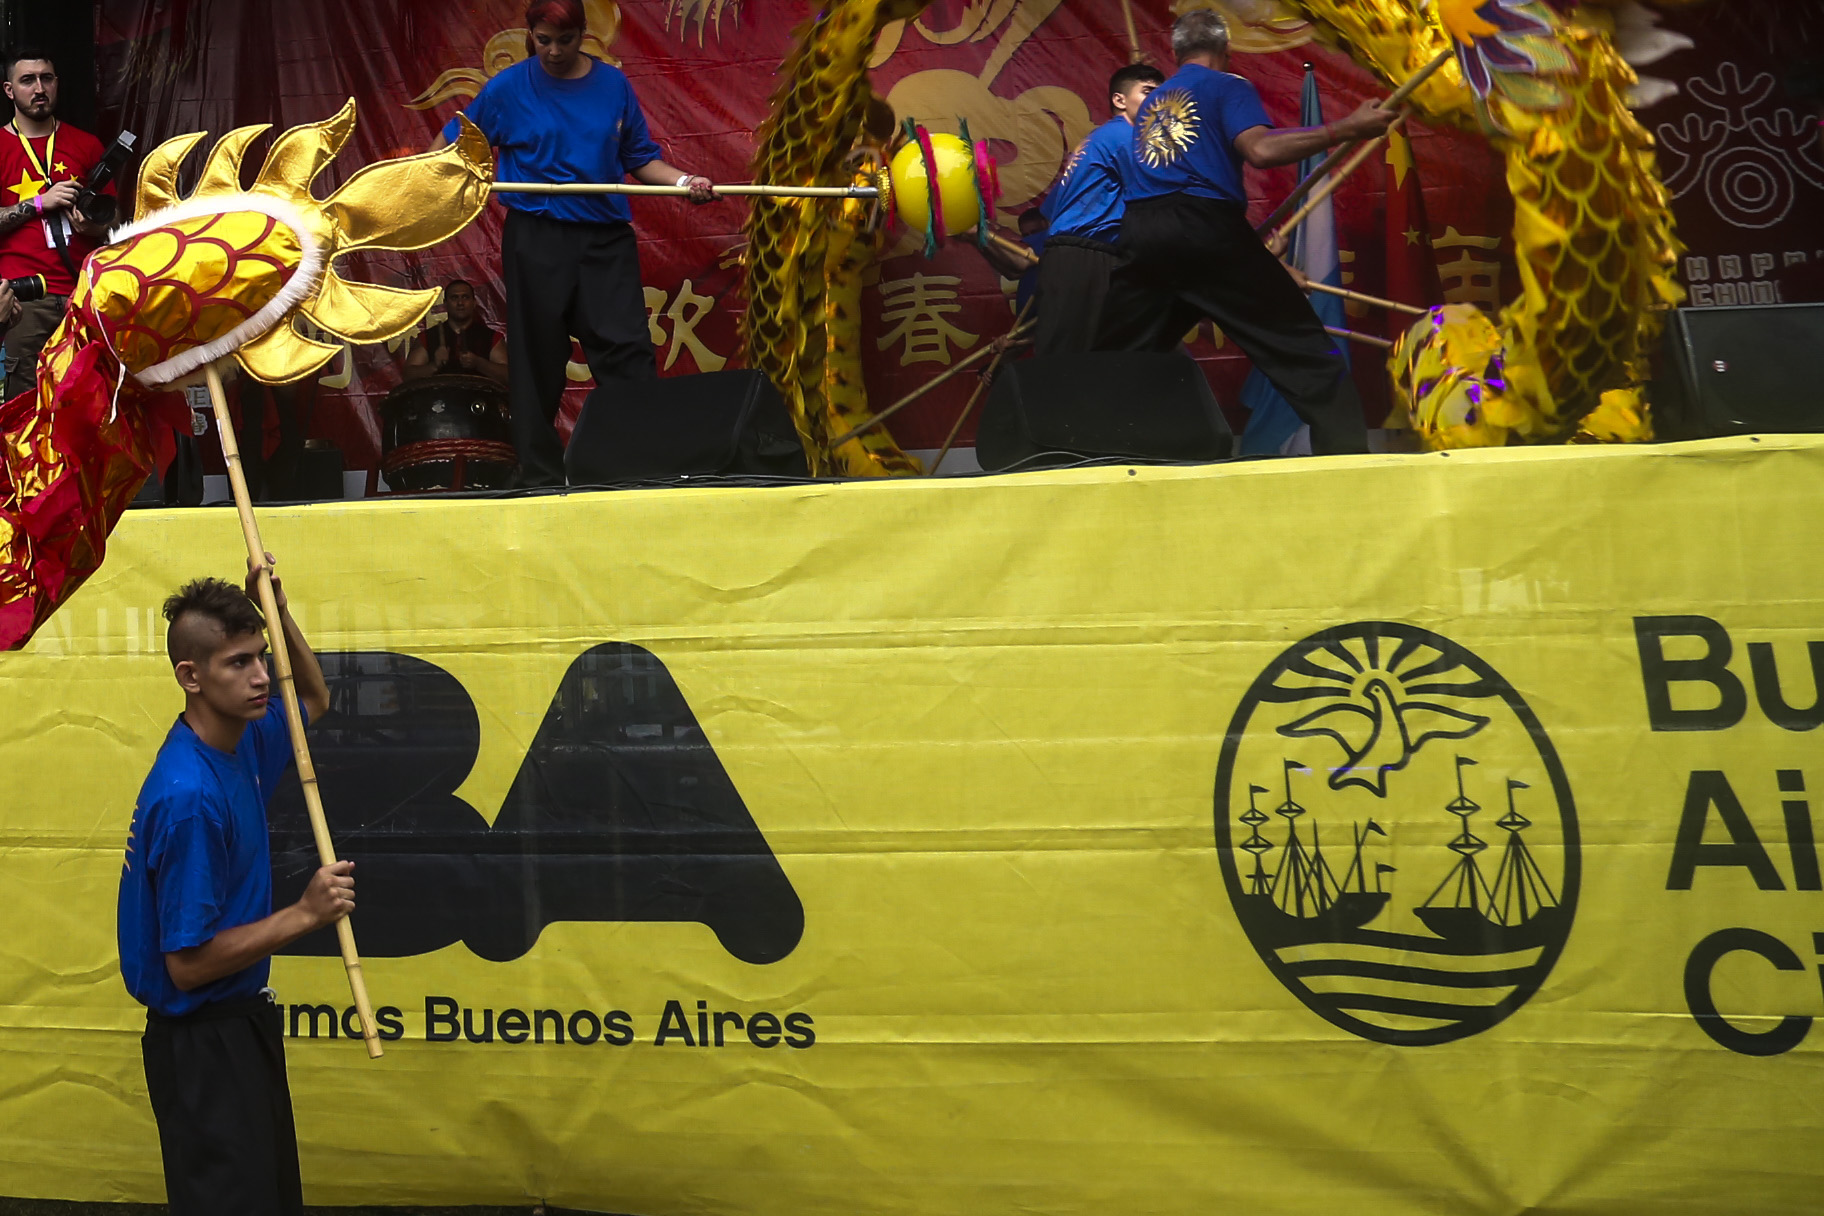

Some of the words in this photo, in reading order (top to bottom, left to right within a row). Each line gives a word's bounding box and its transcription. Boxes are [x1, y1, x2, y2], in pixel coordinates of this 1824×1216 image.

[876, 271, 980, 367] 春
[1690, 280, 1784, 307] CHIN
[425, 995, 634, 1048] Buenos
[654, 999, 817, 1050] Aires
